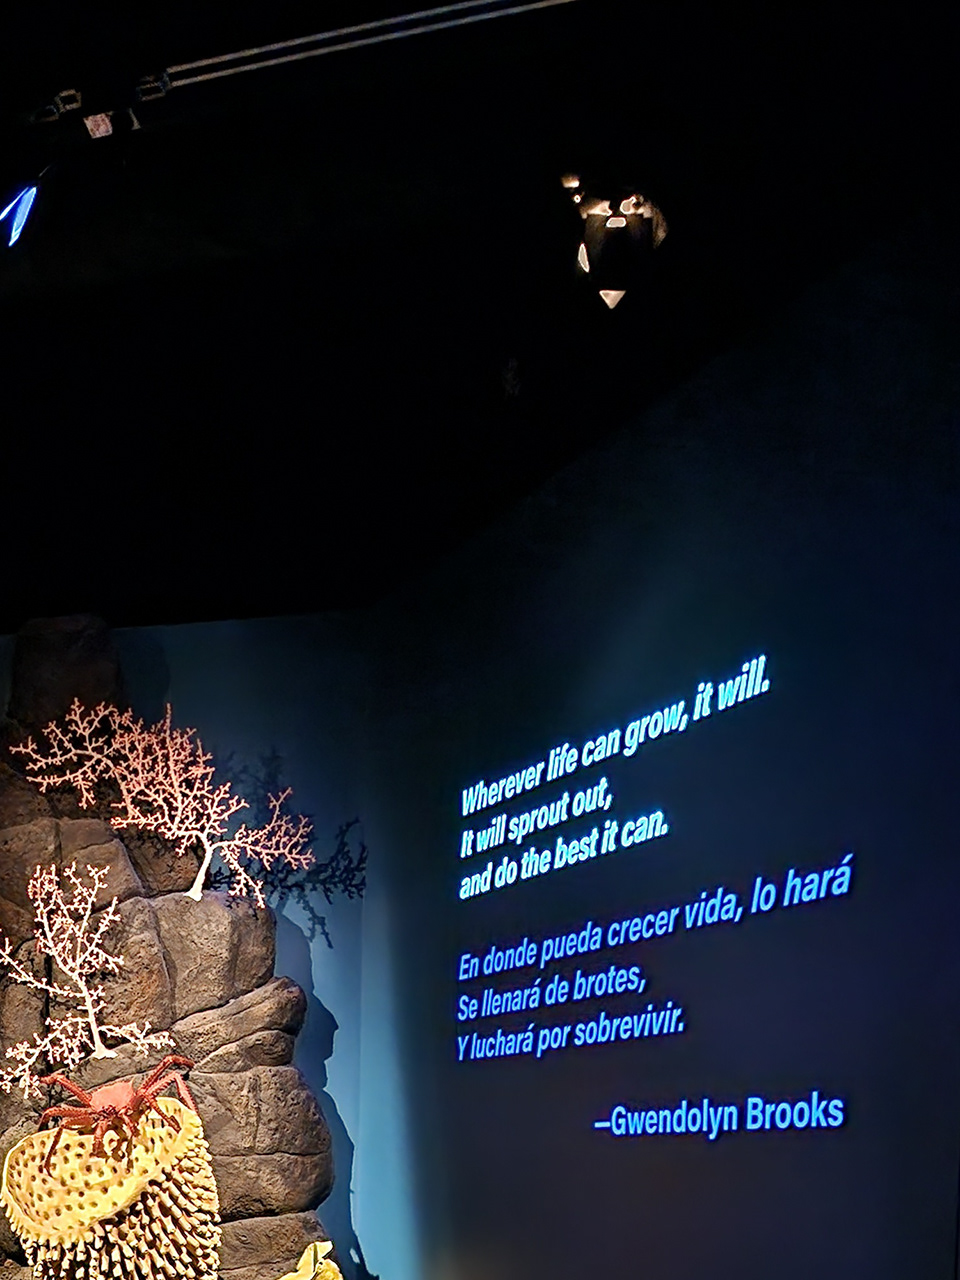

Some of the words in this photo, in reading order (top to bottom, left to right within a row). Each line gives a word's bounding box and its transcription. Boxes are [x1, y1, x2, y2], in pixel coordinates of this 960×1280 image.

[462, 760, 544, 815] Wherever
[547, 743, 578, 781] life
[581, 729, 620, 766] can
[623, 699, 688, 756] grow,
[693, 682, 712, 721] it
[716, 654, 770, 710] will.
[459, 863, 491, 899] and
[495, 856, 517, 884] do
[521, 847, 550, 879] the
[554, 828, 599, 870] best
[601, 820, 618, 853] it
[621, 810, 668, 848] can.
[461, 829, 475, 857] It
[476, 814, 506, 852] will
[508, 792, 569, 846] sprout
[573, 777, 612, 810] out,
[459, 953, 479, 980] En
[483, 938, 538, 975] donde
[540, 921, 601, 968] pueda
[608, 905, 679, 946] crecer
[684, 887, 743, 928] vida,
[751, 877, 776, 913] lo
[782, 854, 854, 907] hará
[458, 995, 478, 1021] Se
[481, 978, 541, 1016] llenará
[545, 974, 569, 1003] de
[573, 964, 646, 1000] brotes,
[458, 1035, 469, 1060] Y
[470, 1023, 535, 1058] luchará
[537, 1024, 571, 1057] por
[574, 1001, 684, 1045] sobrevivir.
[746, 1091, 844, 1130] Brooks
